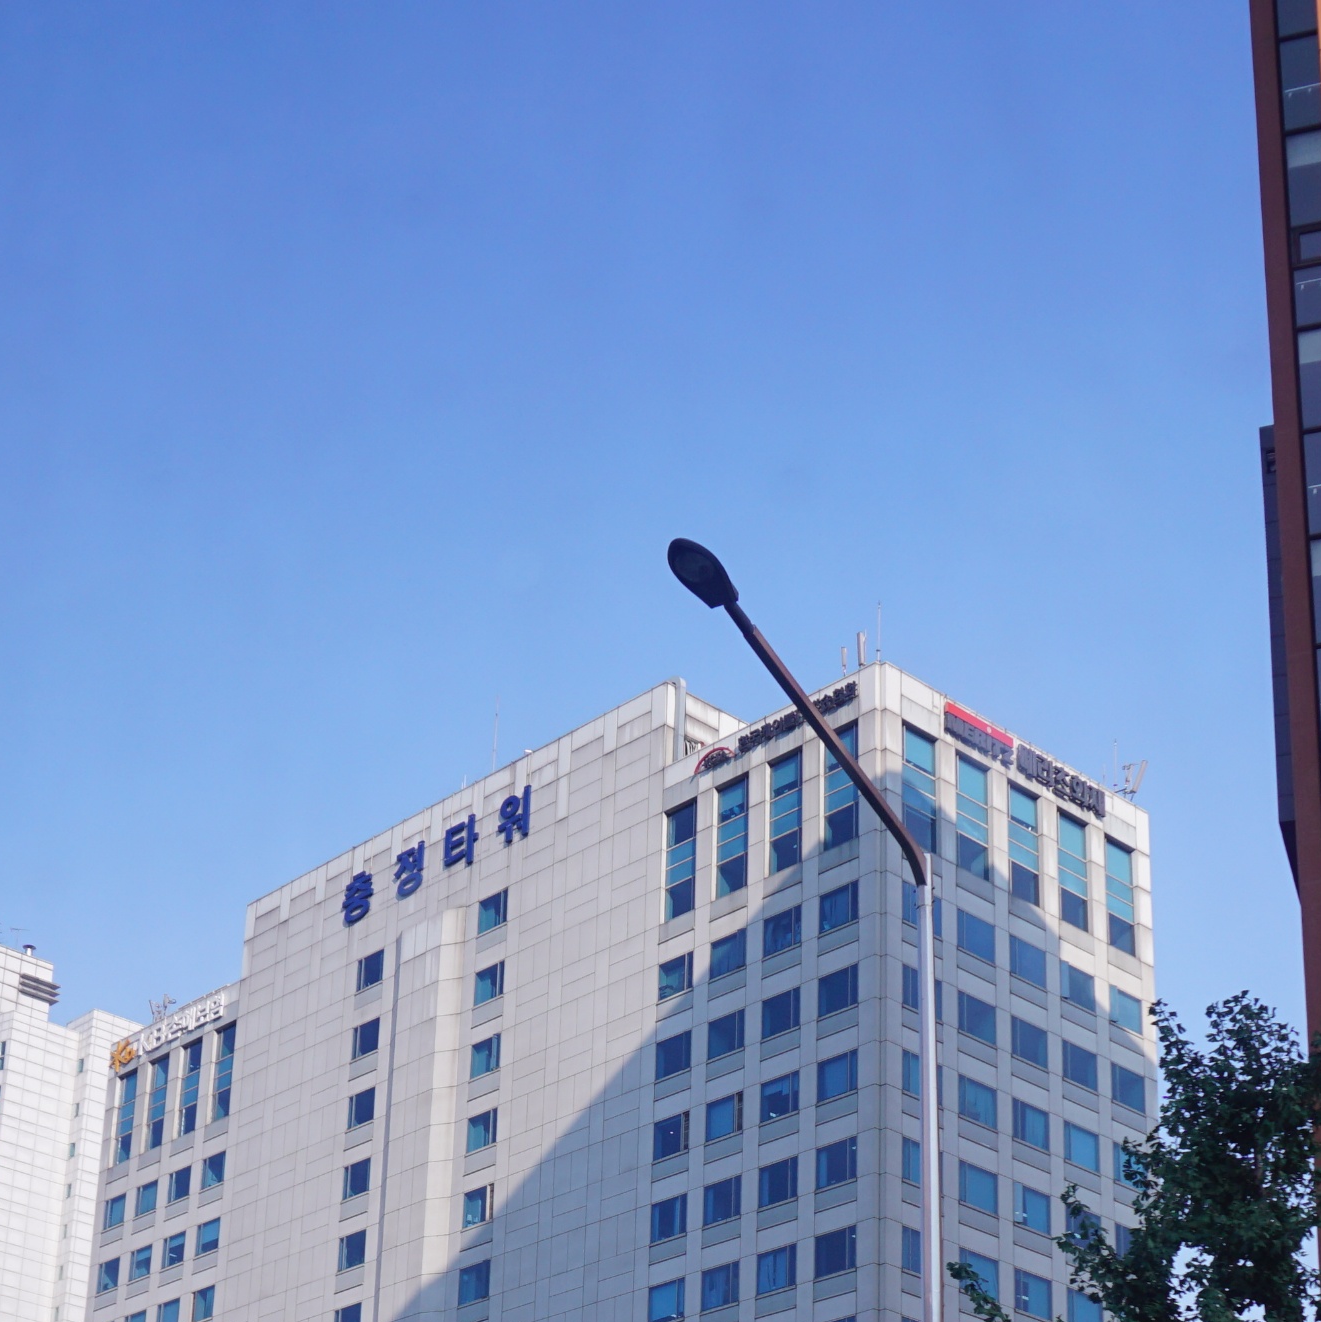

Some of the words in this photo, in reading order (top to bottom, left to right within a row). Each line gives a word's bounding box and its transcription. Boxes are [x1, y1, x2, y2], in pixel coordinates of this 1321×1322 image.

[944, 712, 1014, 767] MERITZ
[1017, 744, 1106, 818] 메리츠화재
[342, 785, 531, 922] 충정타워
[137, 991, 225, 1056] KB손해보험
